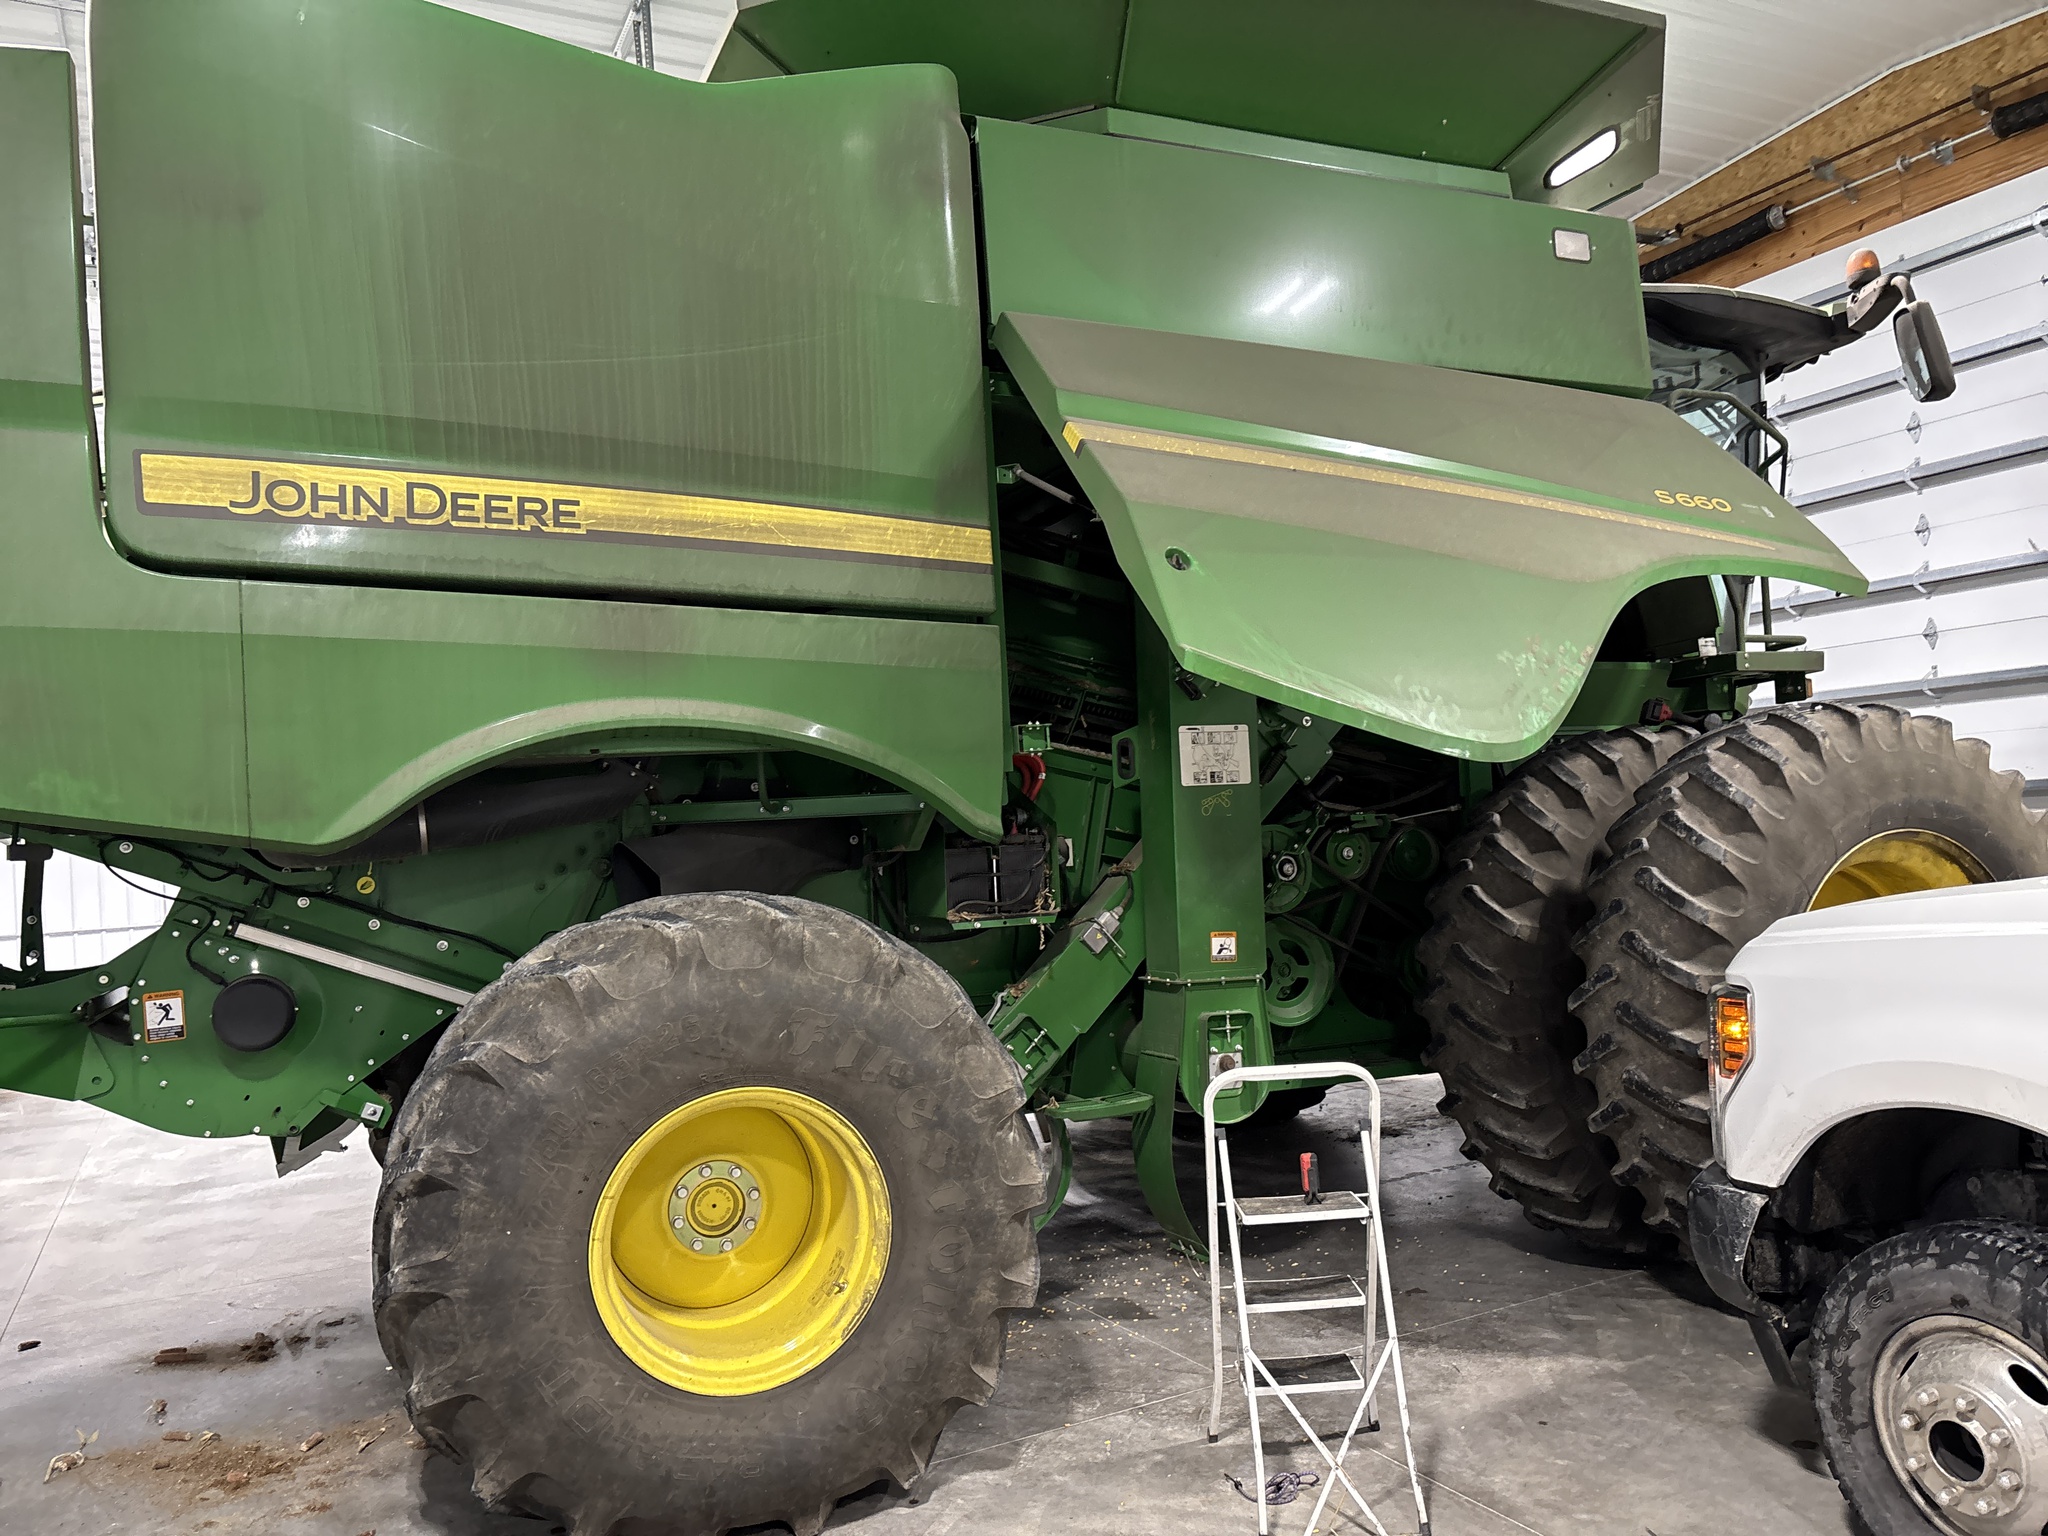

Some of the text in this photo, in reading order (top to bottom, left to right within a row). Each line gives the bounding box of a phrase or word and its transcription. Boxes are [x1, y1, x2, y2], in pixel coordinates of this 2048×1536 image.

[230, 470, 582, 530] JOHN DEERE
[1654, 489, 1732, 512] S660
